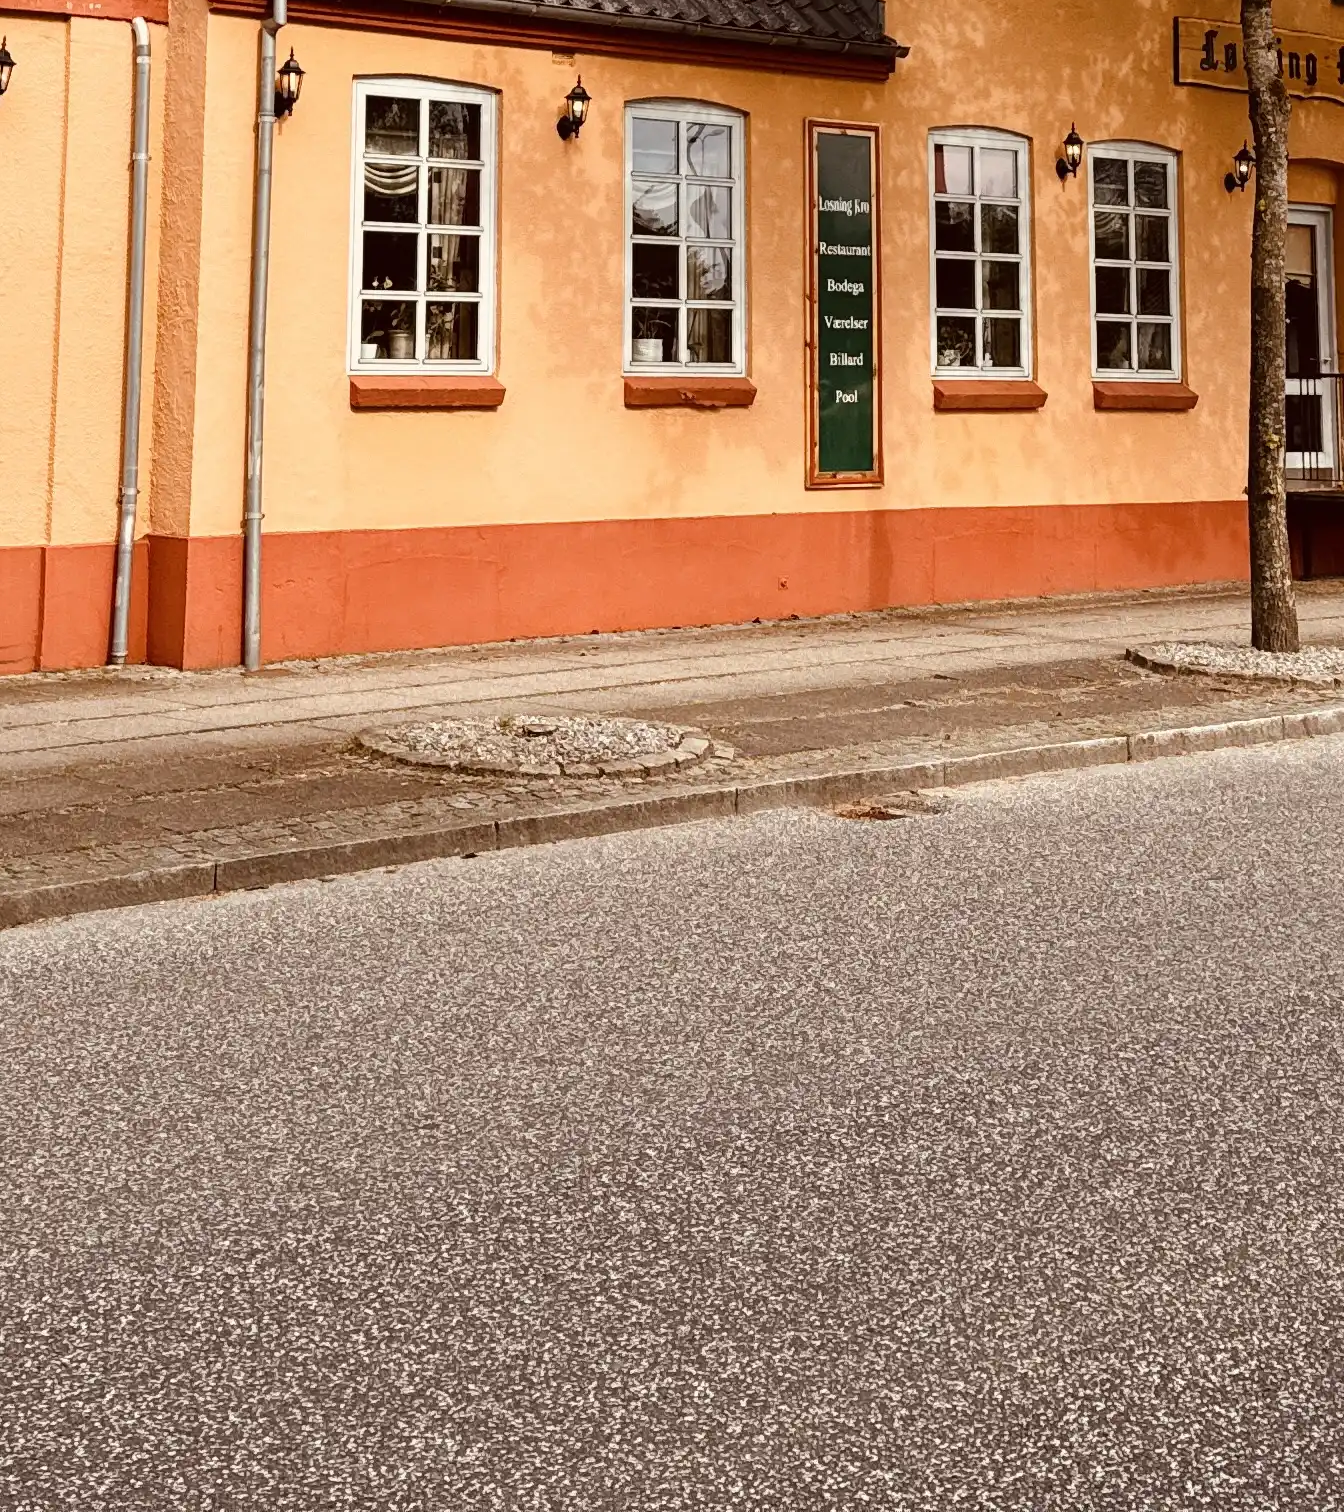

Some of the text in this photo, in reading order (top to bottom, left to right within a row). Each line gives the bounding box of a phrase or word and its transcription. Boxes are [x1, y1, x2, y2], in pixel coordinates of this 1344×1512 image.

[1200, 29, 1318, 86] Løing
[854, 199, 870, 216] Kro
[819, 241, 871, 256] Restaurant
[827, 278, 865, 296] Bodega
[823, 315, 869, 329] Værelser
[829, 352, 864, 366] Billard
[835, 389, 858, 403] Pool
